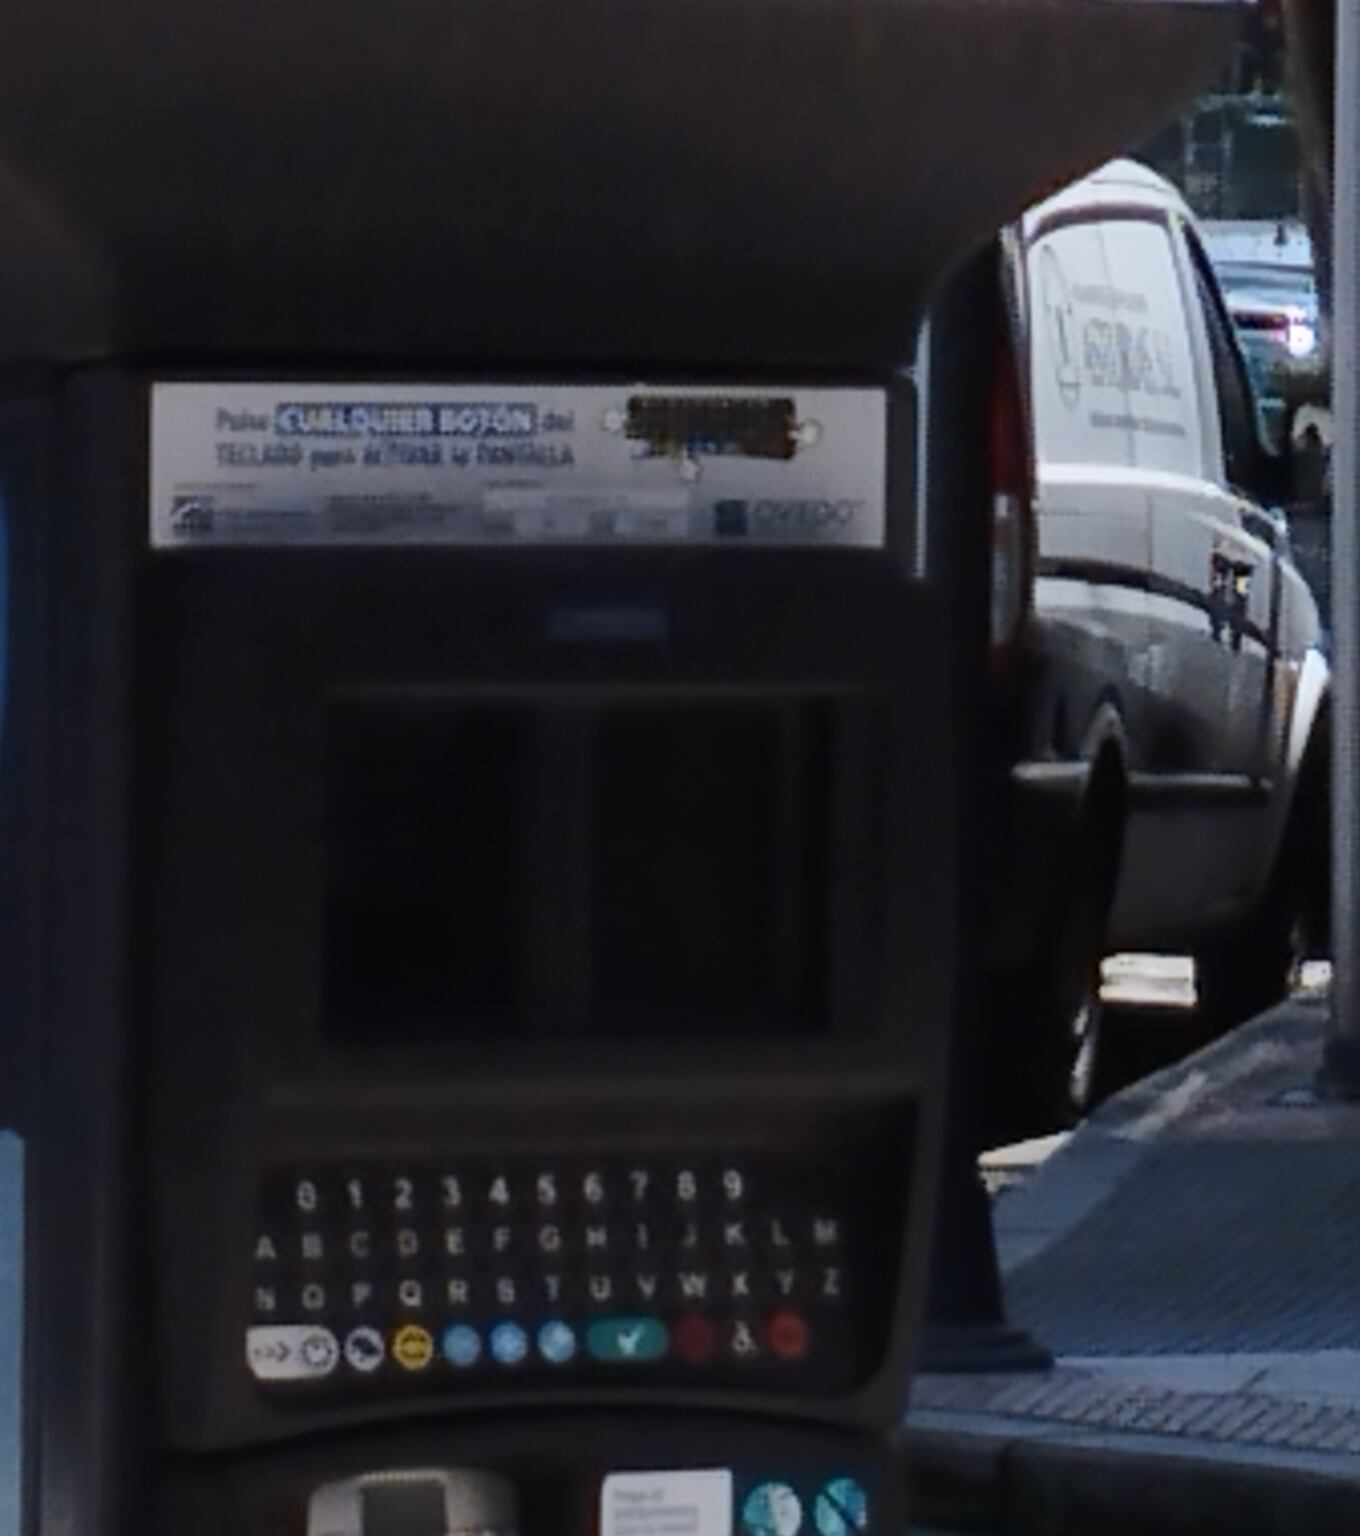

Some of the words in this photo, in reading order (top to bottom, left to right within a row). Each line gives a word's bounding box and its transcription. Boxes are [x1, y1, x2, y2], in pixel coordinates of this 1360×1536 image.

[395, 1178, 413, 1209] 2
[441, 1175, 461, 1206] 3
[488, 1175, 510, 1205] 4
[537, 1174, 556, 1205] 5
[585, 1172, 603, 1202] 6
[630, 1170, 648, 1200] 7
[678, 1170, 696, 1200] 8
[723, 1169, 743, 1199] 9
[256, 1234, 276, 1259] A
[350, 1230, 370, 1258] C
[446, 1226, 463, 1255] E
[493, 1225, 510, 1252] F
[538, 1224, 561, 1252] G
[724, 1221, 744, 1246] K
[771, 1219, 790, 1245] L
[813, 1218, 837, 1243] M
[301, 1283, 324, 1310] O
[400, 1279, 421, 1308] Q
[447, 1279, 468, 1304] R
[544, 1274, 560, 1302] T
[590, 1274, 611, 1300] U
[637, 1272, 656, 1300] V
[679, 1272, 706, 1298] W
[731, 1270, 749, 1296] X
[777, 1268, 794, 1294] Y
[822, 1267, 840, 1295] Z
